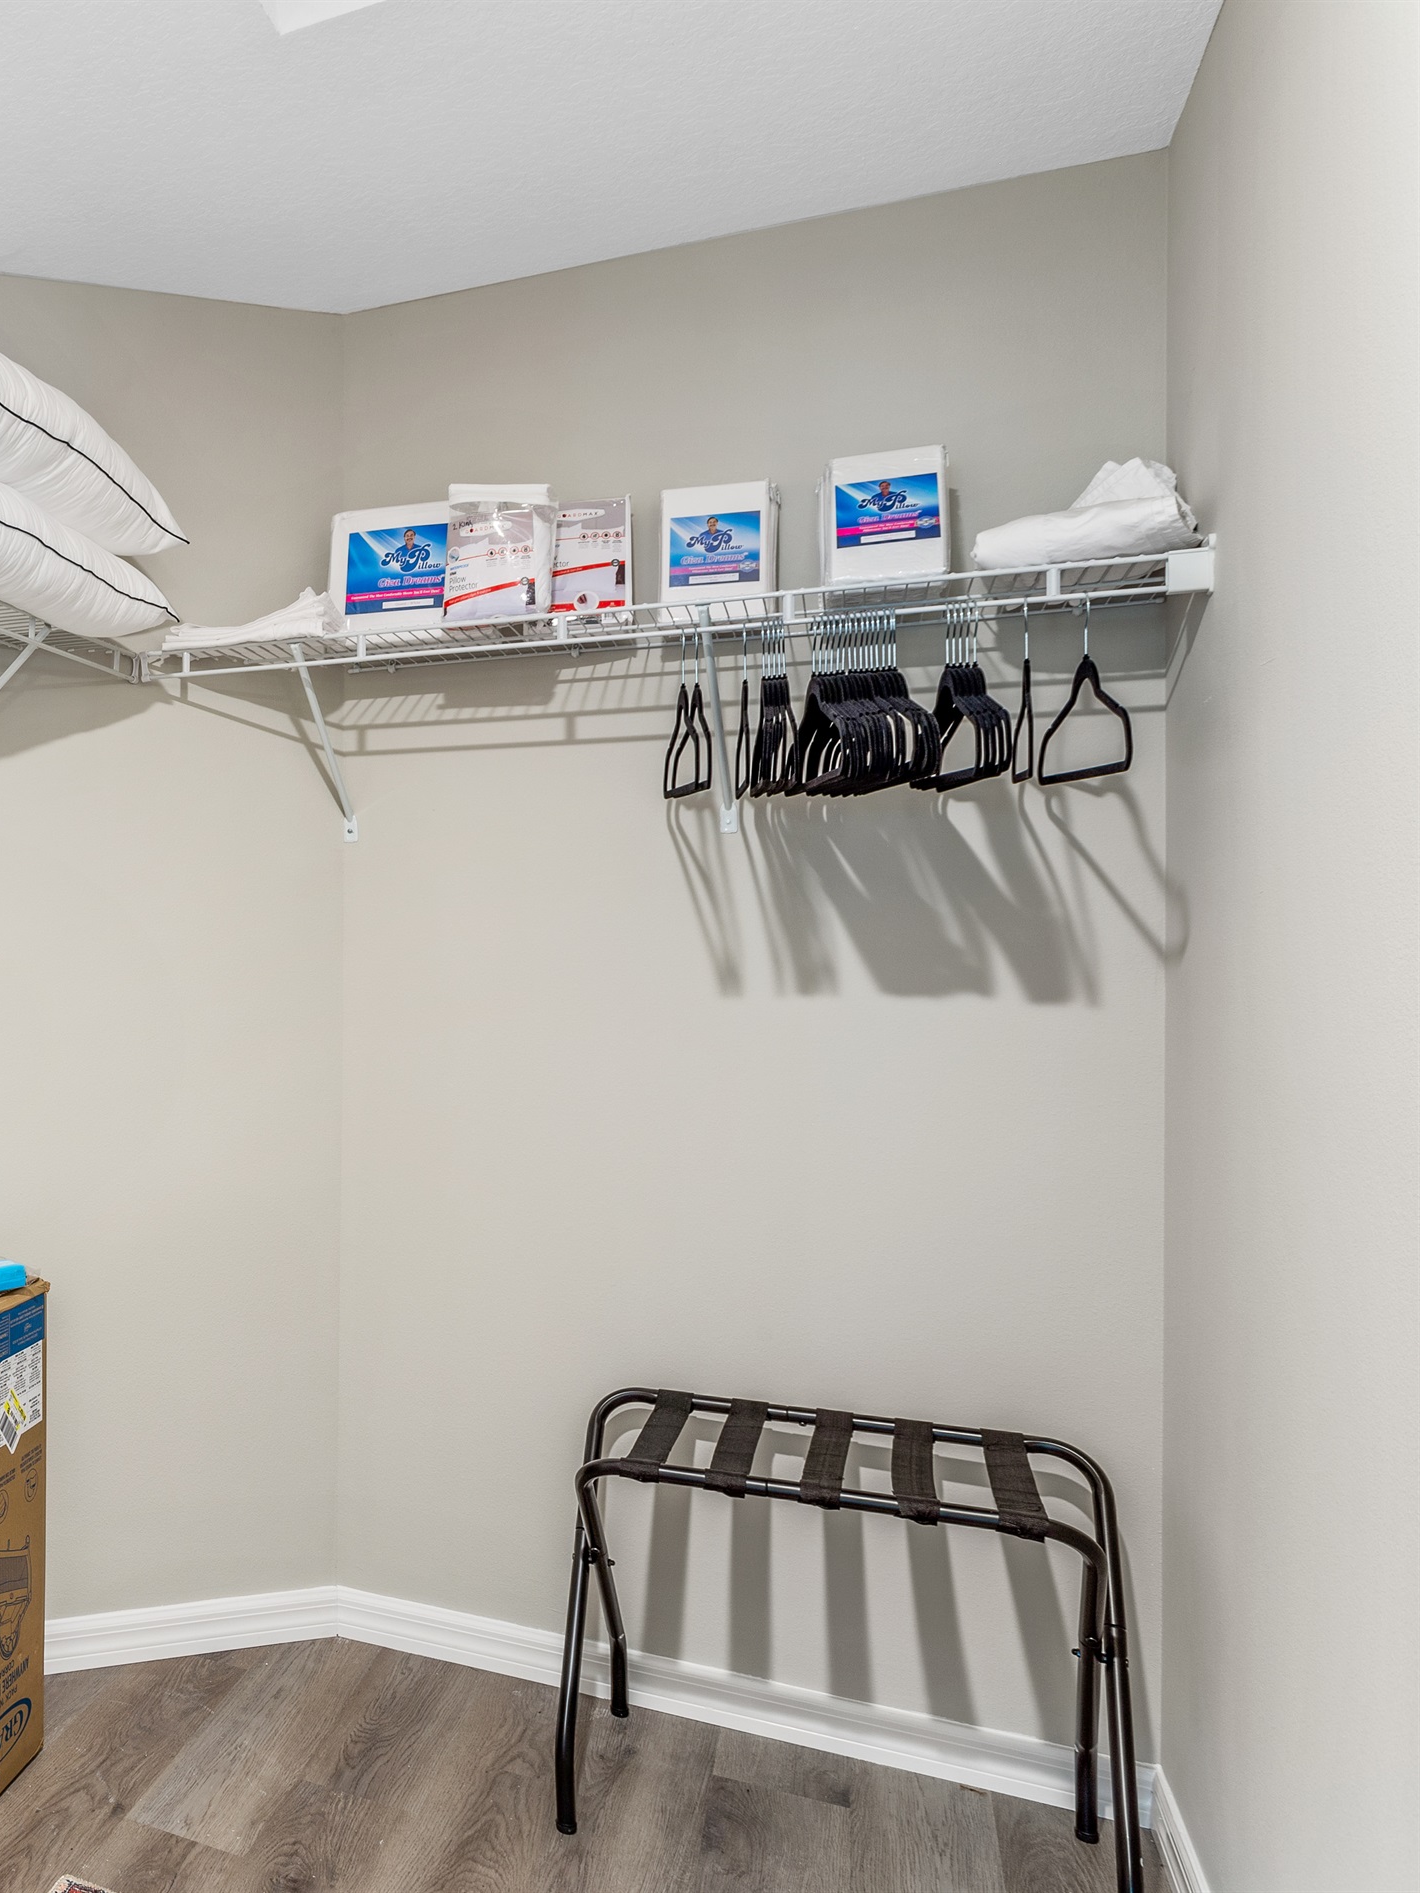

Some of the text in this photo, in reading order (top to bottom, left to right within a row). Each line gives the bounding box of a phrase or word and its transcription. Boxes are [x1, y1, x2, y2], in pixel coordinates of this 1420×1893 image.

[858, 490, 918, 512] MyPillow
[686, 529, 742, 553] MyPillow
[381, 544, 441, 573] MyPillow
[403, 574, 441, 585] Dreams
[449, 582, 478, 592] Protector
[2, 1655, 29, 1691] ANYWHERE
[5, 1684, 17, 1703] PACK
